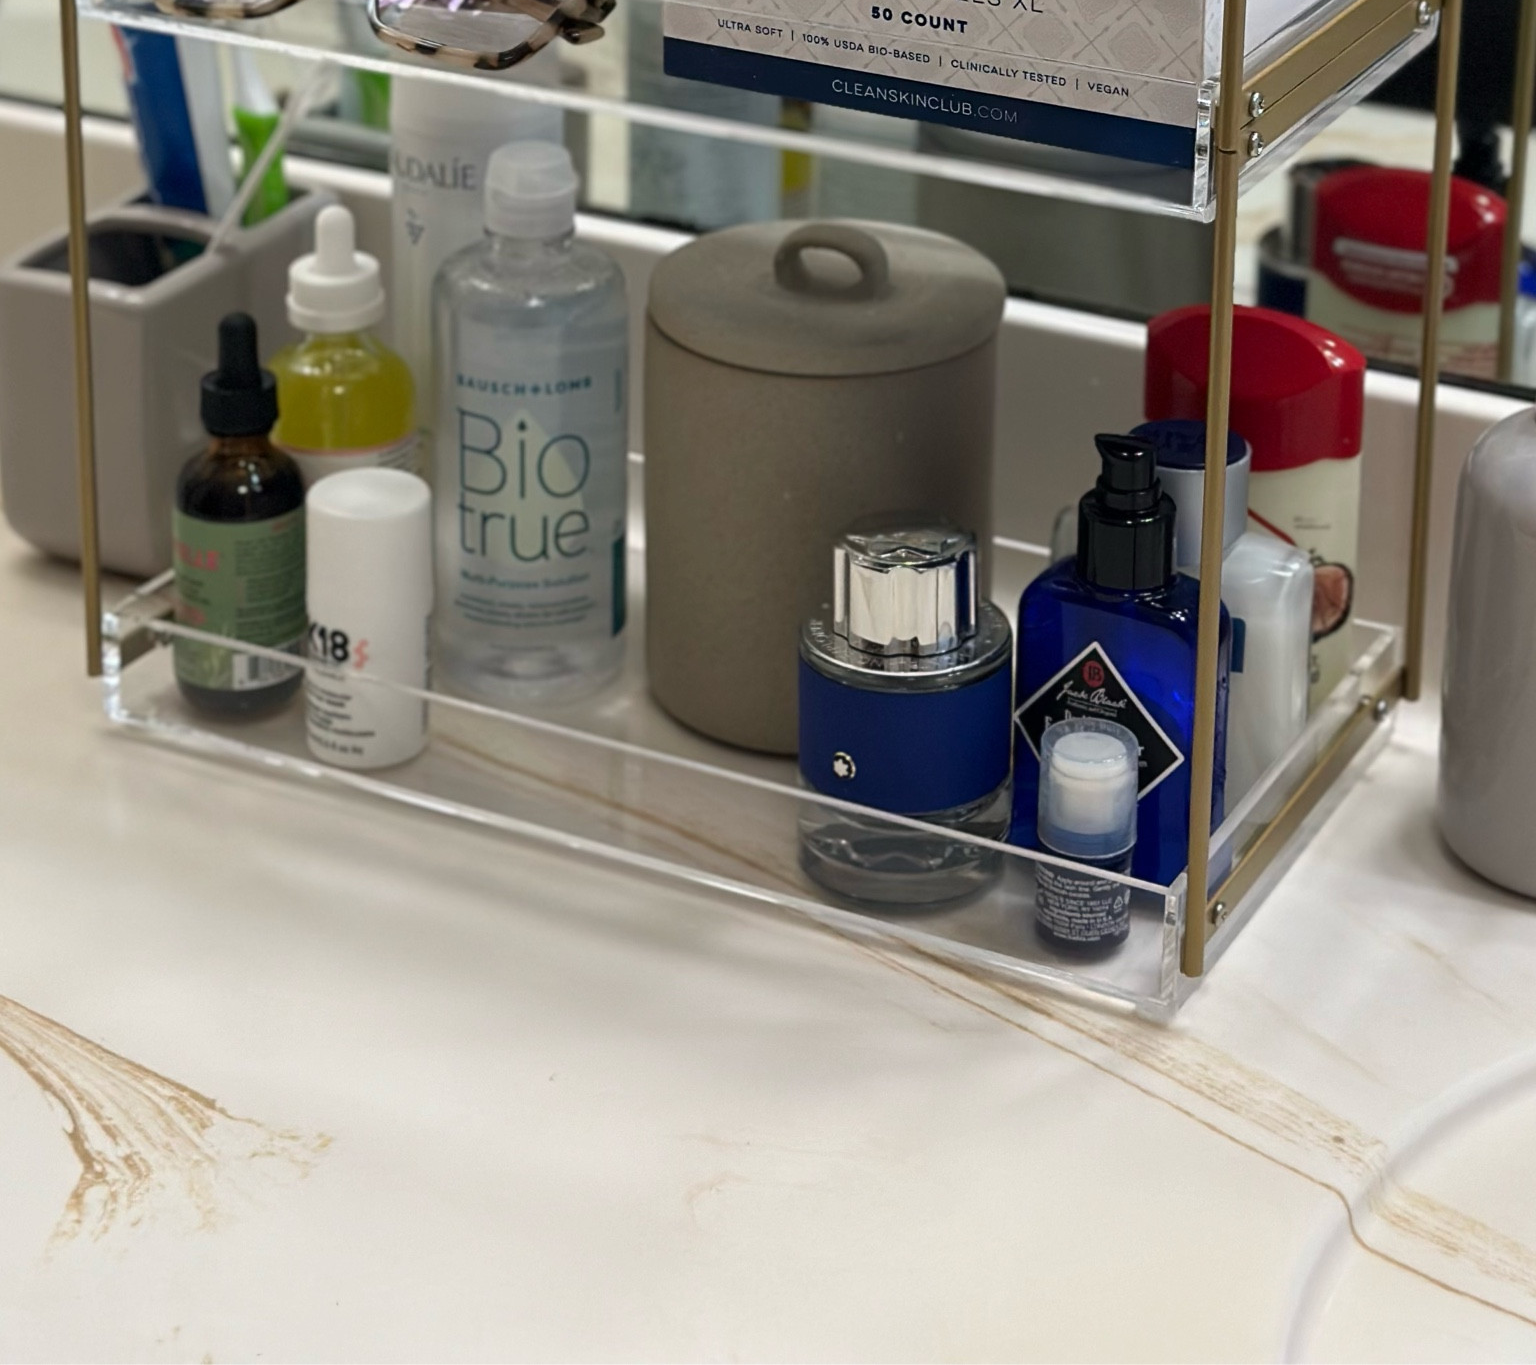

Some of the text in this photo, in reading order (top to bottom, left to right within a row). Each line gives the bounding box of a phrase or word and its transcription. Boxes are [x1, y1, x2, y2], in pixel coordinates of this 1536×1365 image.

[871, 6, 968, 34] 50 COUNT
[718, 18, 1130, 97] ULTRA SOFT 100% USDA BIO-BASED CLINICALLY TESTED VEGAN
[831, 79, 1019, 124] CLEANSKINCLUB.COM
[456, 407, 590, 500] Bio
[458, 489, 590, 562] true
[1056, 680, 1127, 708] Jack Black
